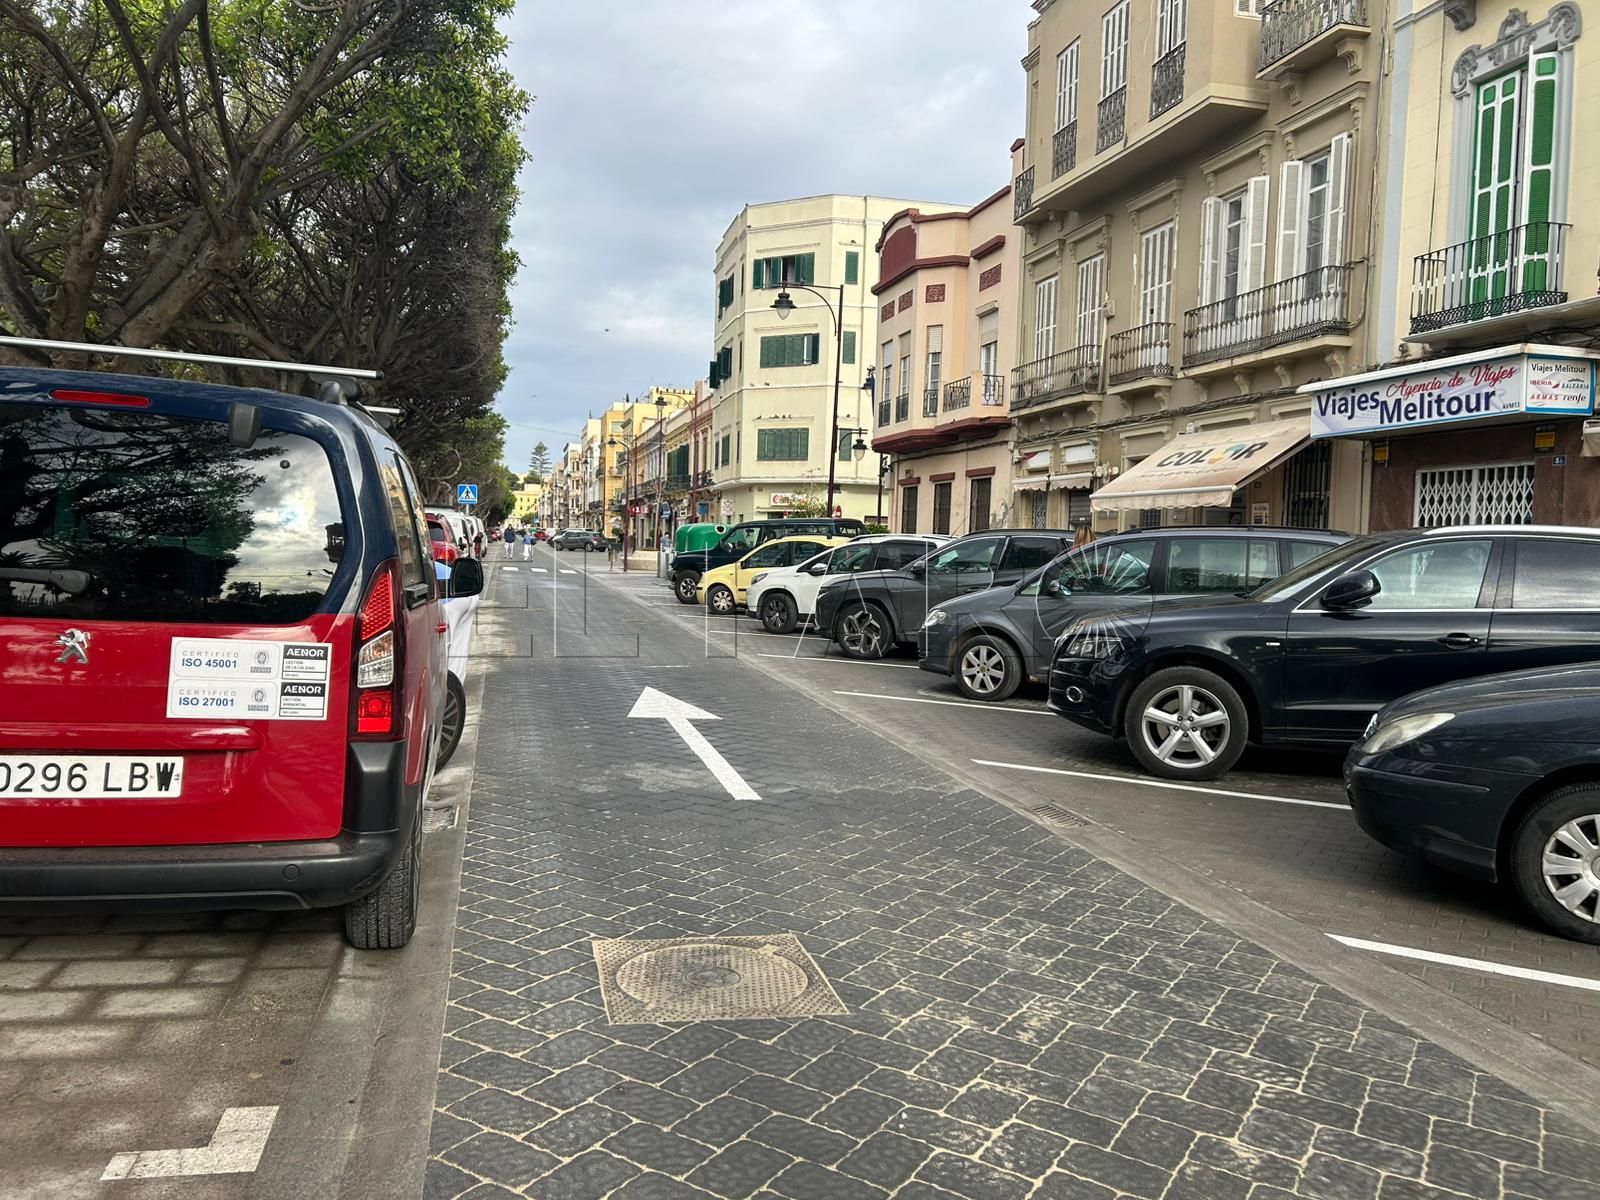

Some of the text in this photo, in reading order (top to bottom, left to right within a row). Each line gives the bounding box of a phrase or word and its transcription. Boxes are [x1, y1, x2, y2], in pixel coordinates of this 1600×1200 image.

[1531, 363, 1587, 374] Viajes Melitour
[1386, 363, 1518, 400] Agencia de Viajes
[1316, 388, 1380, 420] Viajes
[1563, 393, 1587, 404] renfe
[1380, 389, 1496, 425] Melitour
[1156, 441, 1269, 468] COLOR
[181, 650, 240, 659] CERTIFIED
[286, 648, 325, 658] AENOR
[181, 658, 238, 669] ISO 45001
[178, 689, 238, 697] CERTIFIED
[283, 685, 322, 694] AENOR
[178, 697, 235, 707] ISO 27001
[0, 762, 176, 793] 0296 LBW
